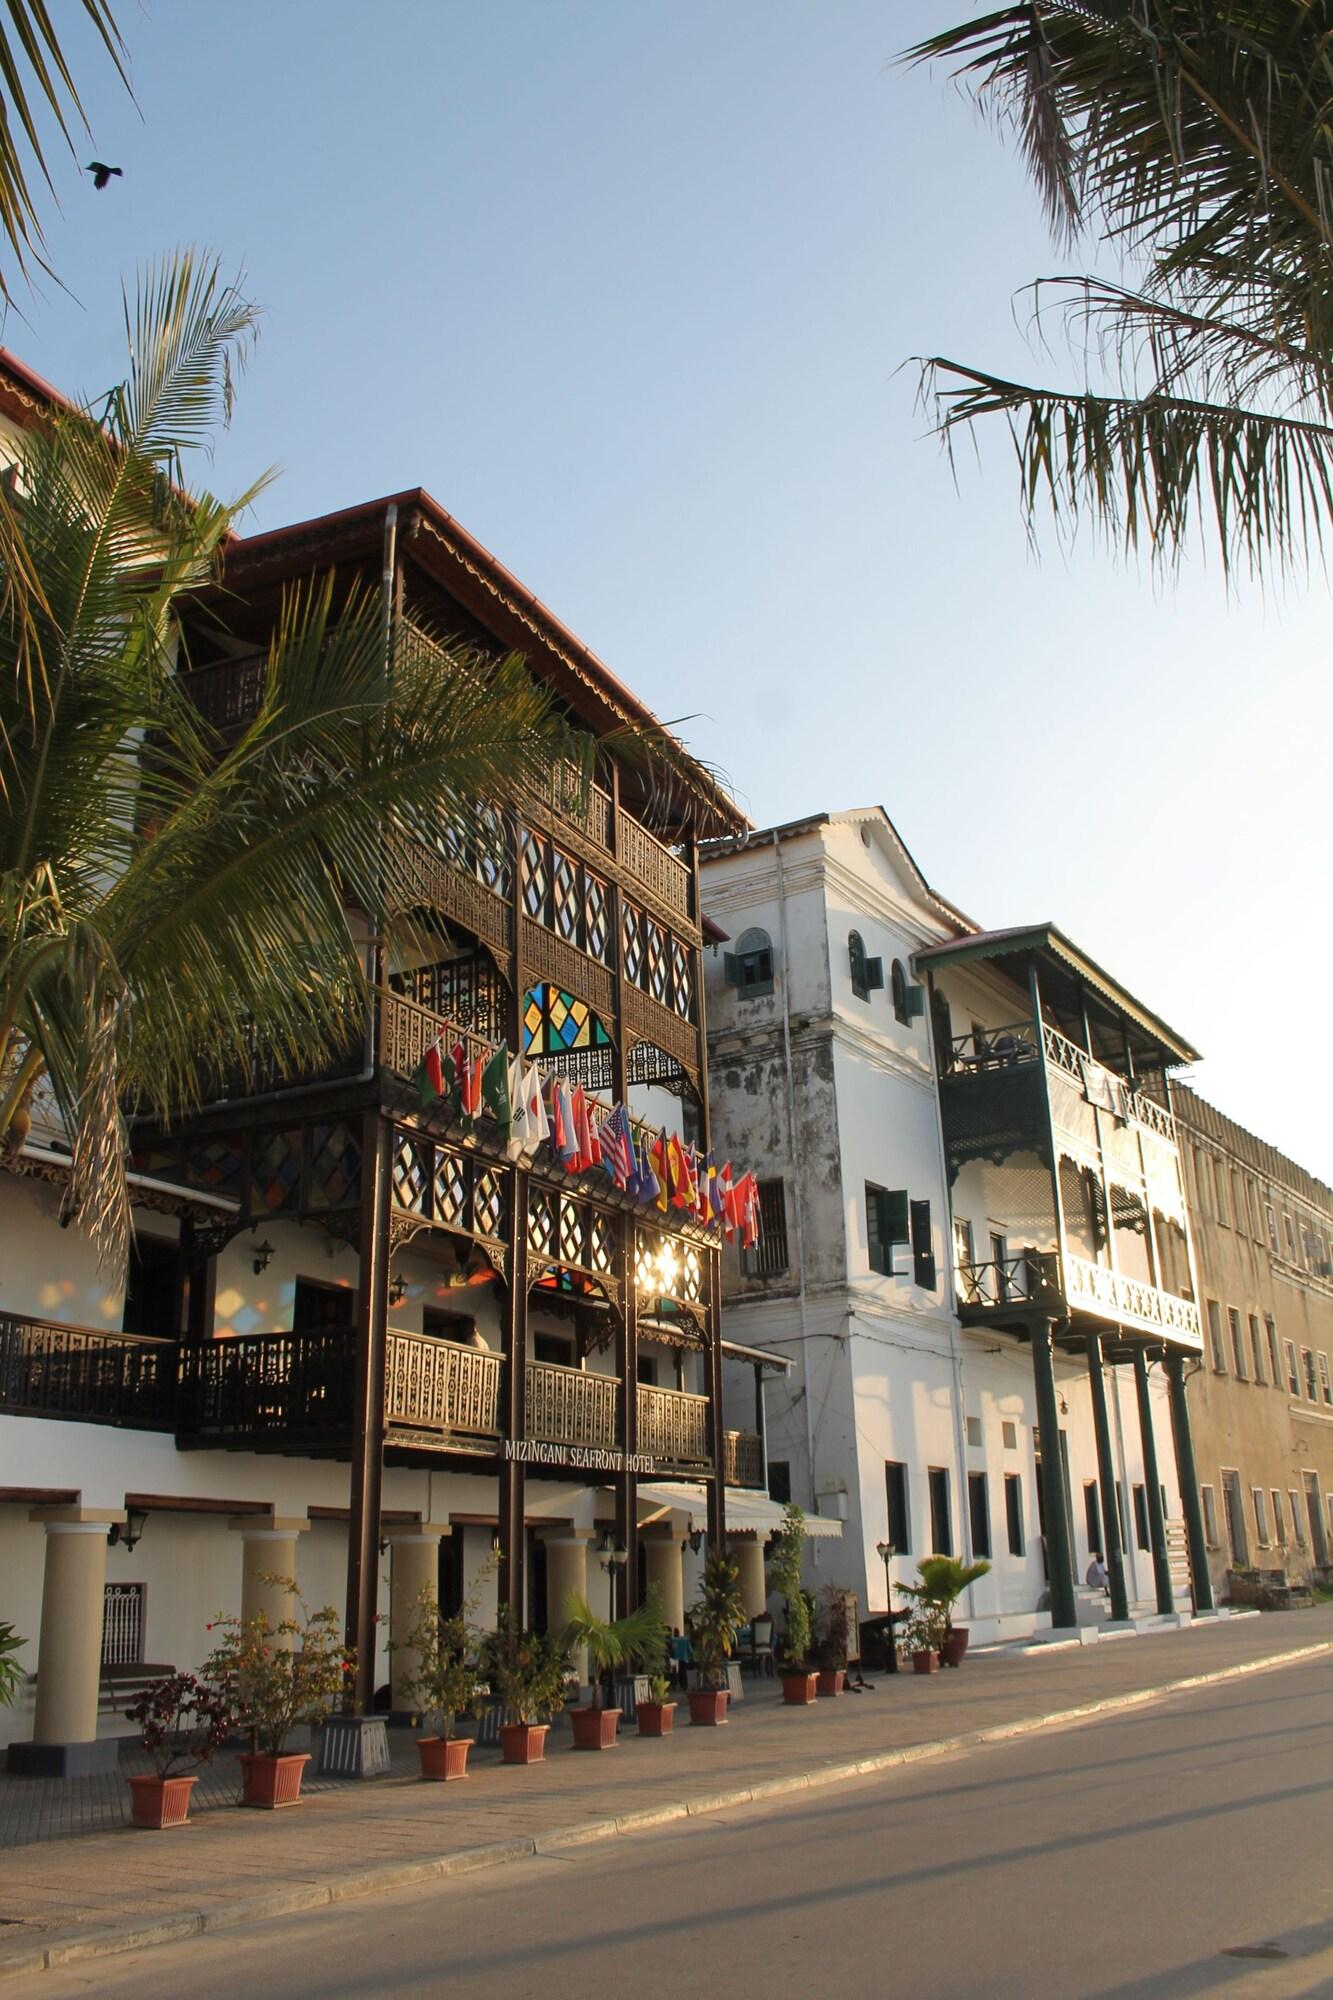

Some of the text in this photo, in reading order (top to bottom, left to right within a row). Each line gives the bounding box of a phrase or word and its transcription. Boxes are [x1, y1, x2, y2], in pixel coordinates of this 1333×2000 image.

[505, 1439, 656, 1474] MIZINGANI SEAFRONT HOTEL
